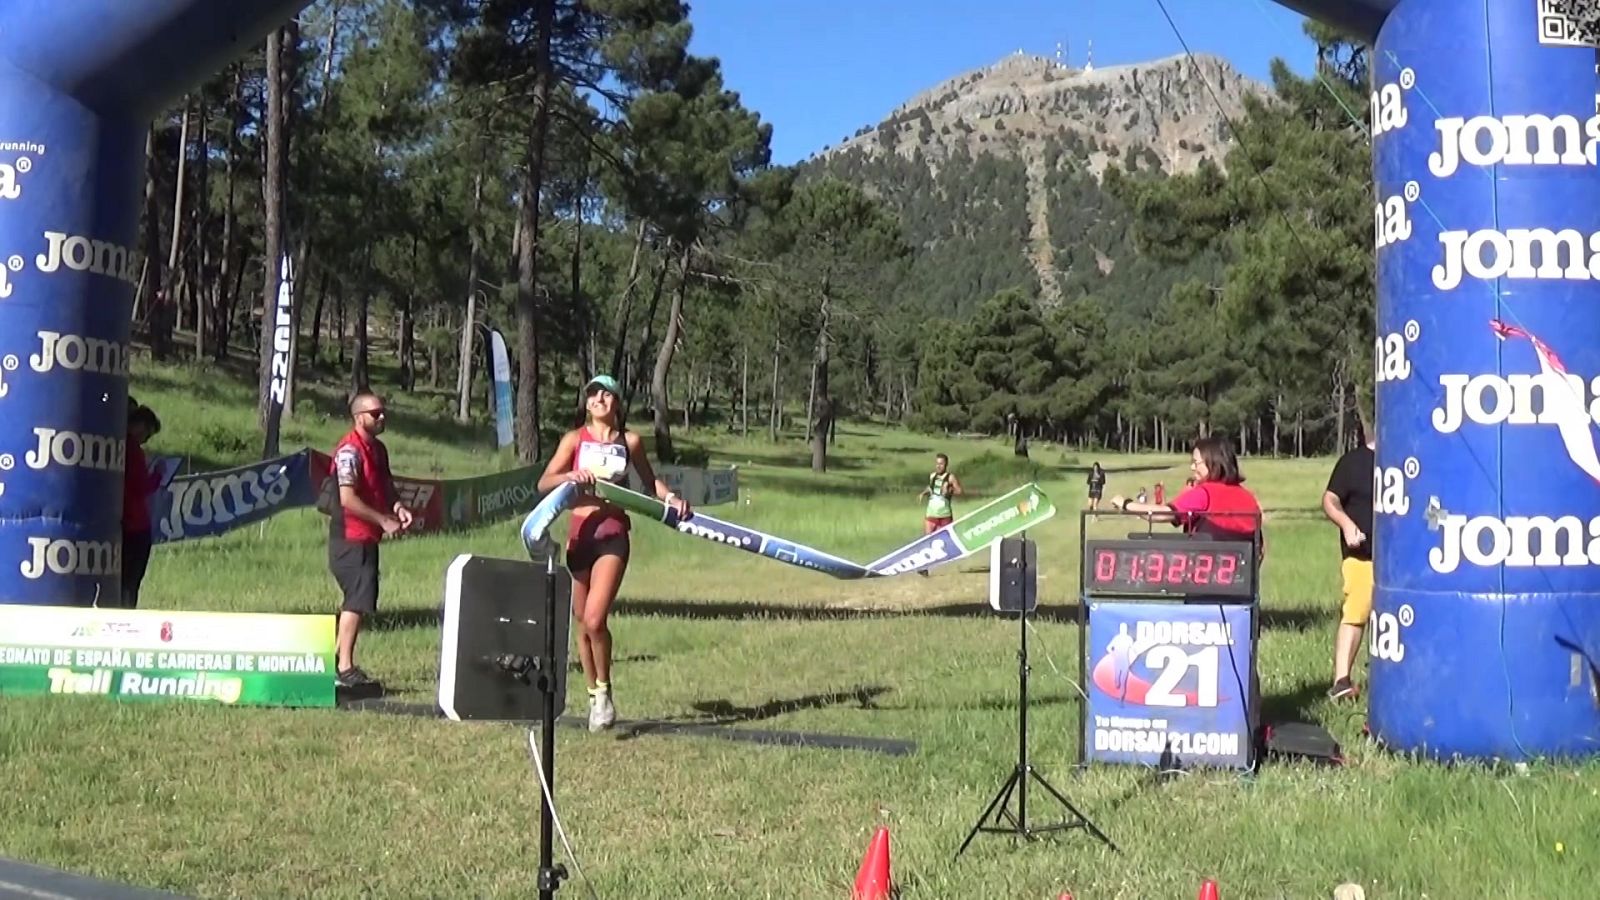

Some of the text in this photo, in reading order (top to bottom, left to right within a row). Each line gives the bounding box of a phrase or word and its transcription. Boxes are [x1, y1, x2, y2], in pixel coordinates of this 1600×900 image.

[1432, 228, 1600, 291] Jom
[160, 463, 290, 540] Joma
[1095, 551, 1237, 584] 01:32:22
[1428, 514, 1600, 573] Jom
[47, 668, 242, 703] Trail Running
[53, 649, 72, 665] DE
[76, 648, 131, 668] ESPAÑA
[135, 651, 154, 668] DE
[158, 652, 232, 671] CARRERAS
[235, 654, 254, 671] DE
[258, 653, 325, 673] MONTAÑA
[1144, 645, 1219, 708] 21
